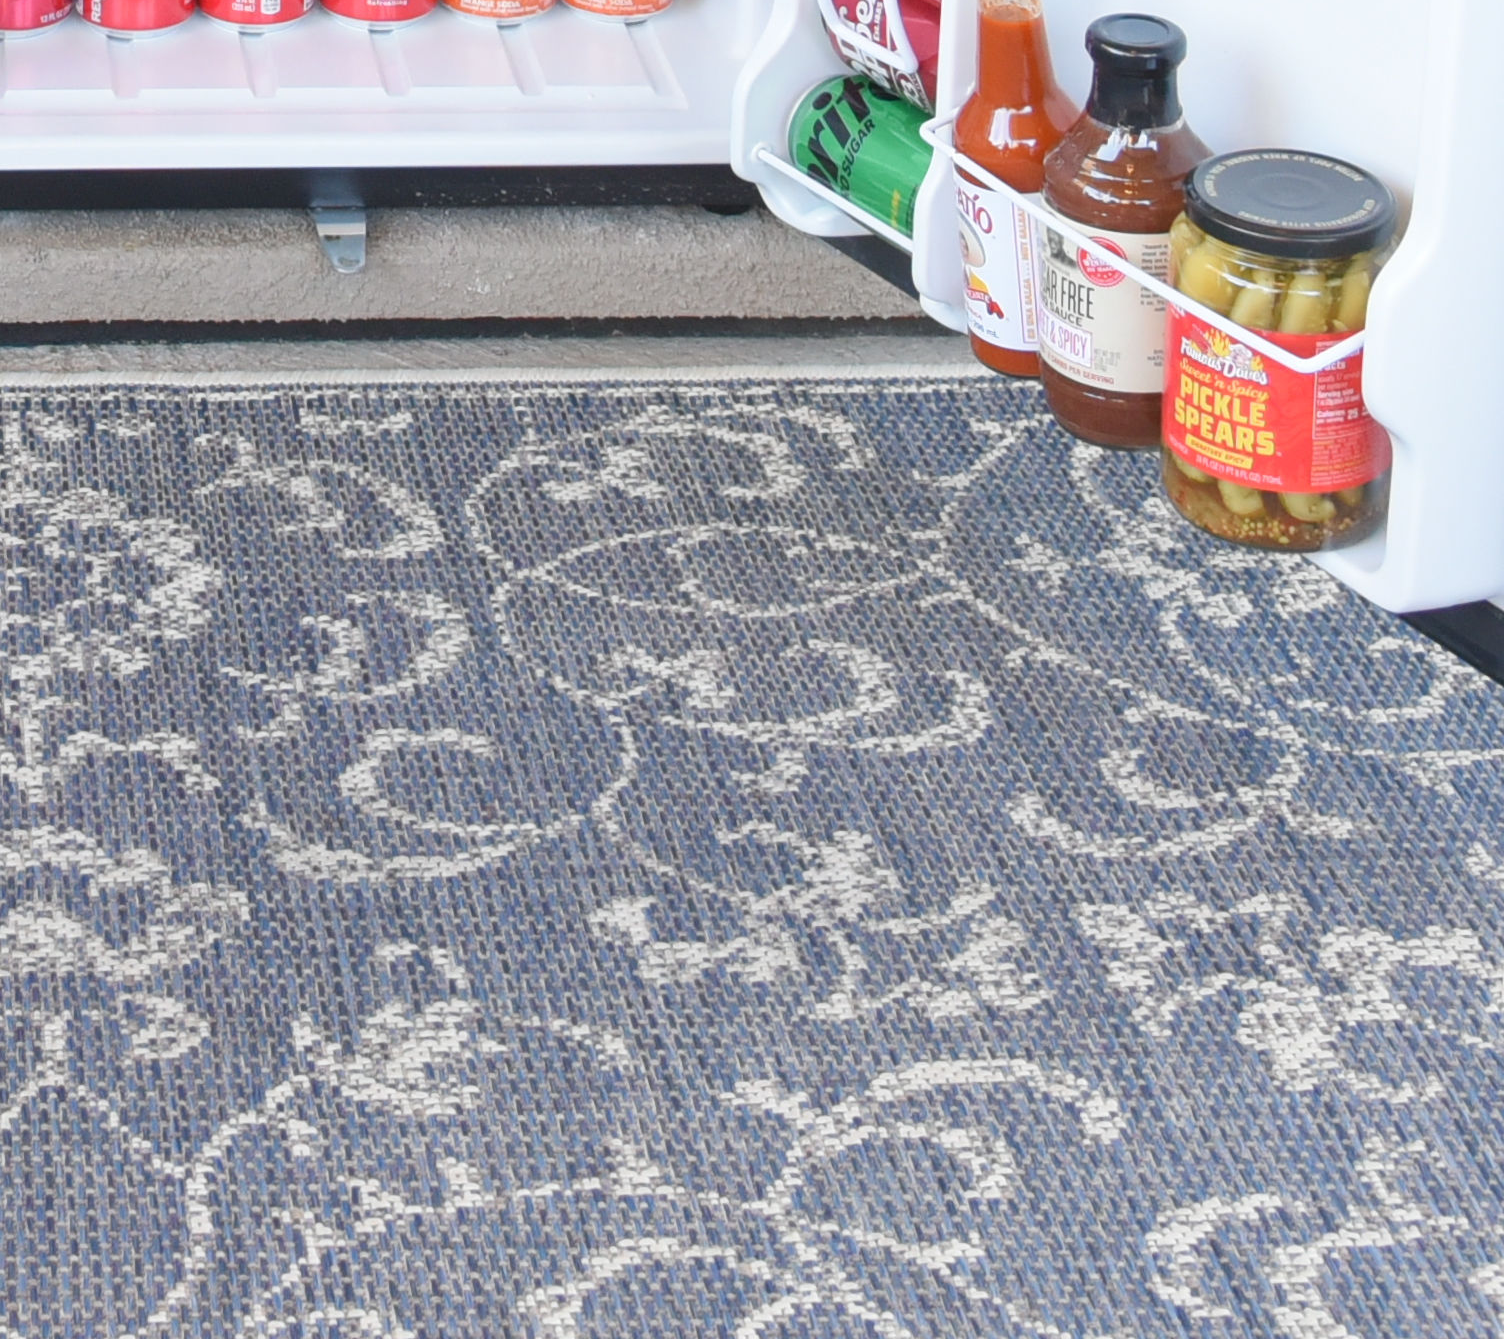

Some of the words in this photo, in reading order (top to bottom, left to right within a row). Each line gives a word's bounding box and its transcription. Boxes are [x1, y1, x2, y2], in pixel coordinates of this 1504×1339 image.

[495, 0, 521, 9] SODA
[842, 118, 878, 175] SUGAR
[956, 185, 994, 235] ATÍO
[1023, 278, 1034, 306] SALSA
[1060, 276, 1096, 321] FREE
[1049, 303, 1084, 328] SAUCE
[1049, 320, 1057, 346] &
[1058, 325, 1088, 360] SPICY
[1180, 336, 1222, 371] Famous
[1223, 358, 1269, 386] Dave's
[1083, 369, 1115, 385] SERVING
[1180, 357, 1212, 384] Sweet
[1227, 380, 1270, 403] Spicy
[1181, 373, 1267, 428] PICKLE
[1175, 397, 1275, 457] SPEARS
